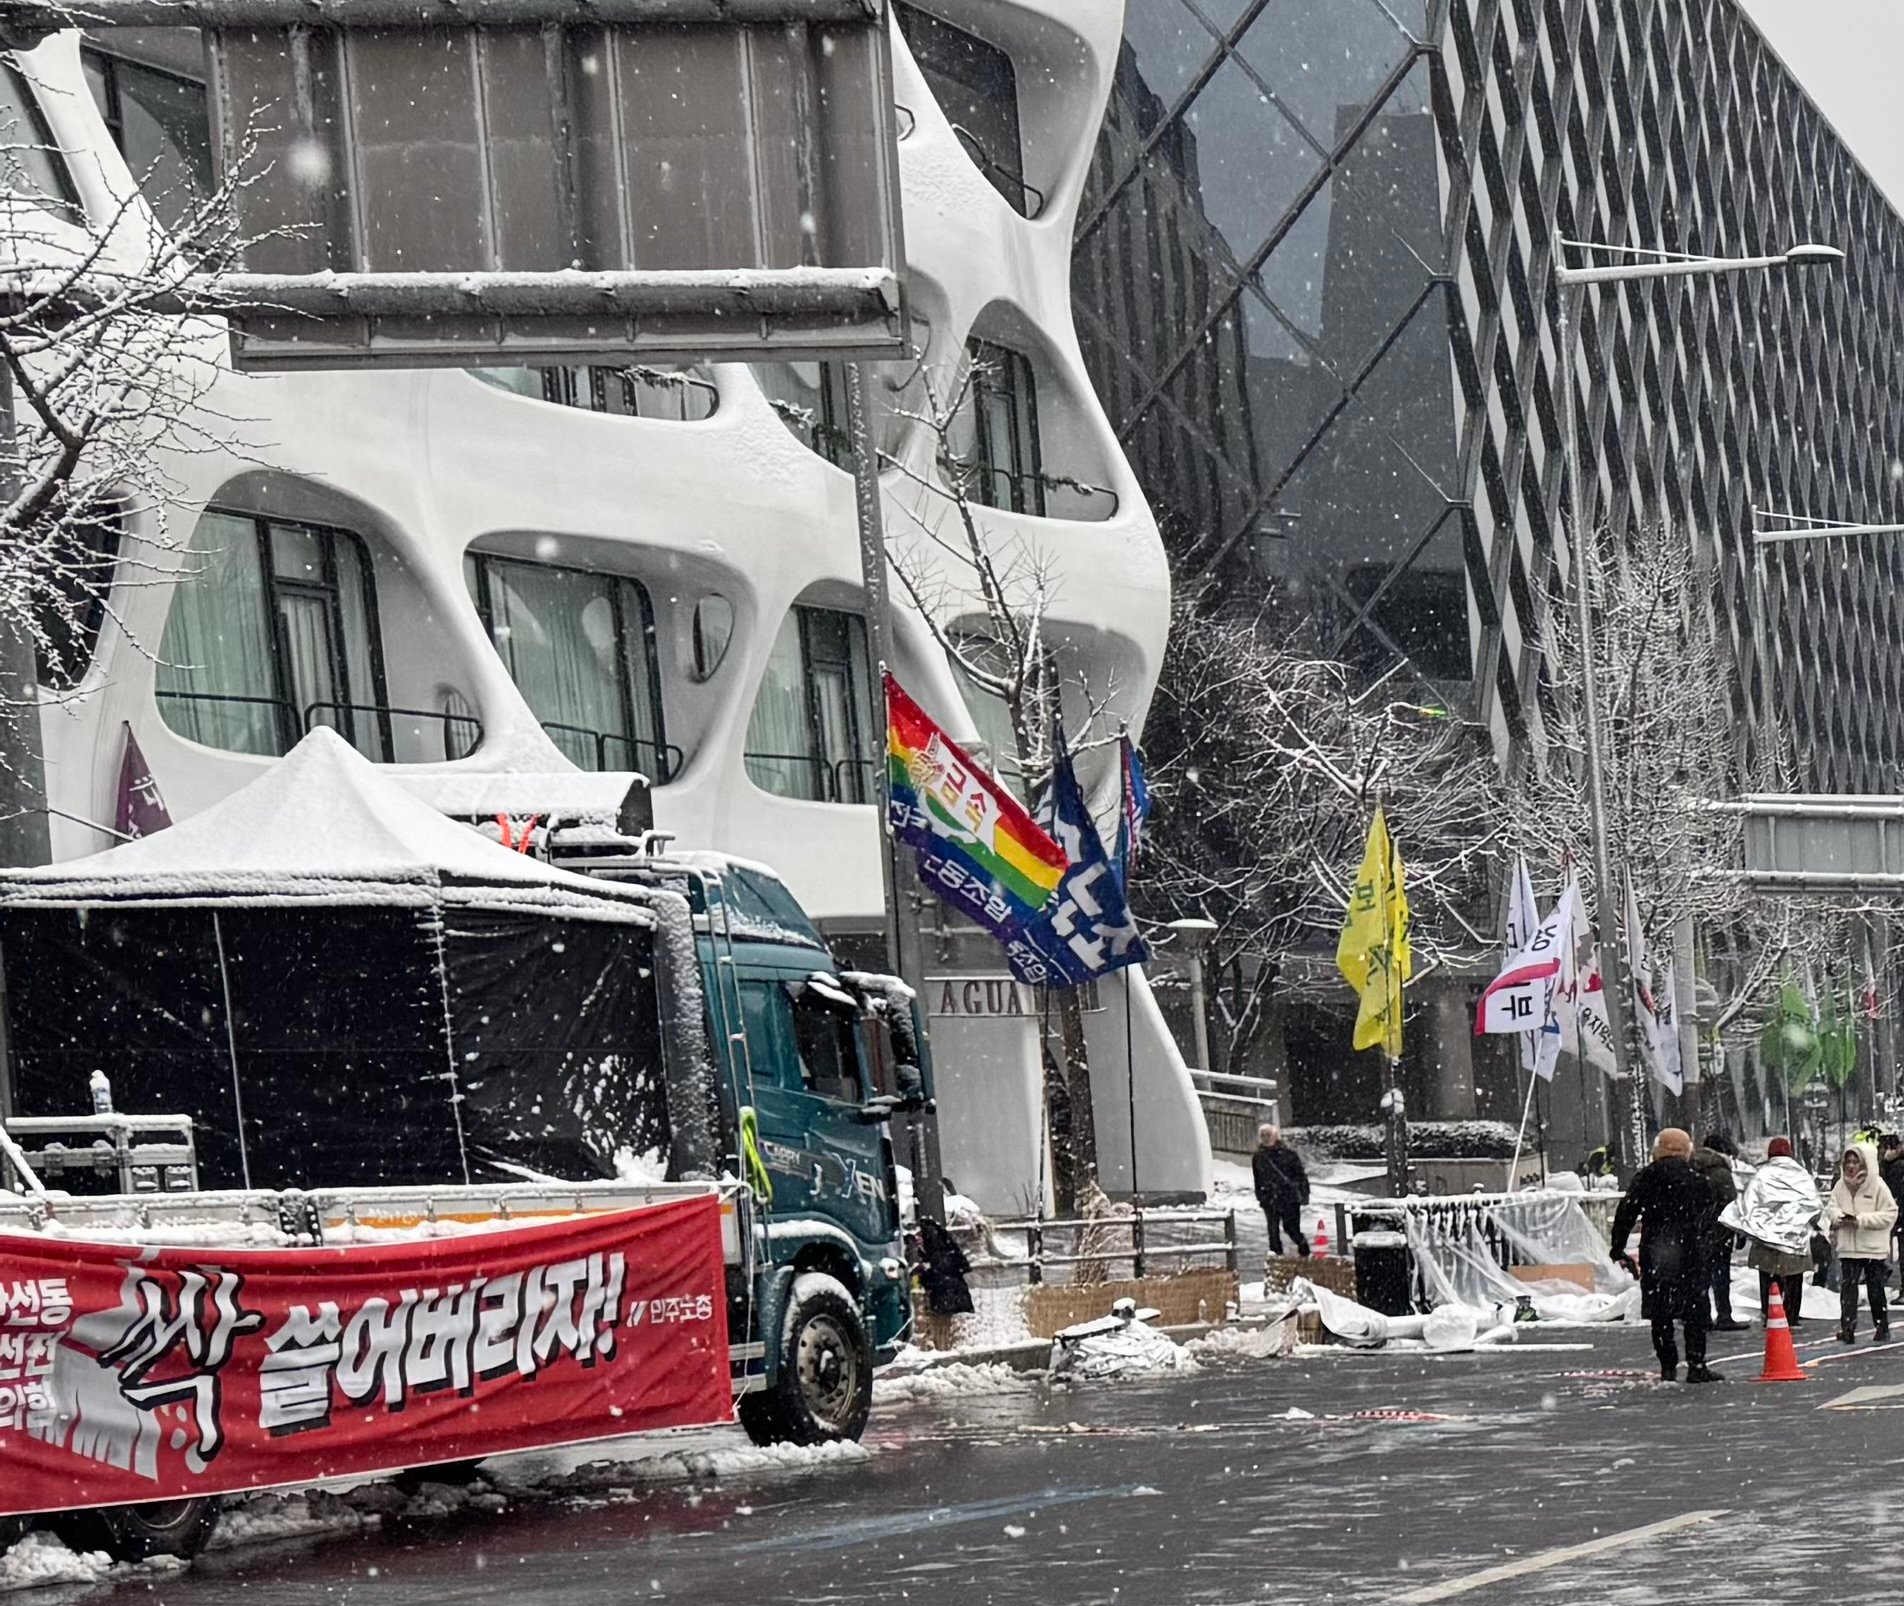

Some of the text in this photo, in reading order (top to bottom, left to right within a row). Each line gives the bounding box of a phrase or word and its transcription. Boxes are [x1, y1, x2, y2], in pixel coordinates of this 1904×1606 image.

[0, 1278, 74, 1327] 선동
[258, 1251, 628, 1432] 쓸어버리자!
[649, 1292, 713, 1326] 민주노총
[97, 1264, 267, 1463] 싹
